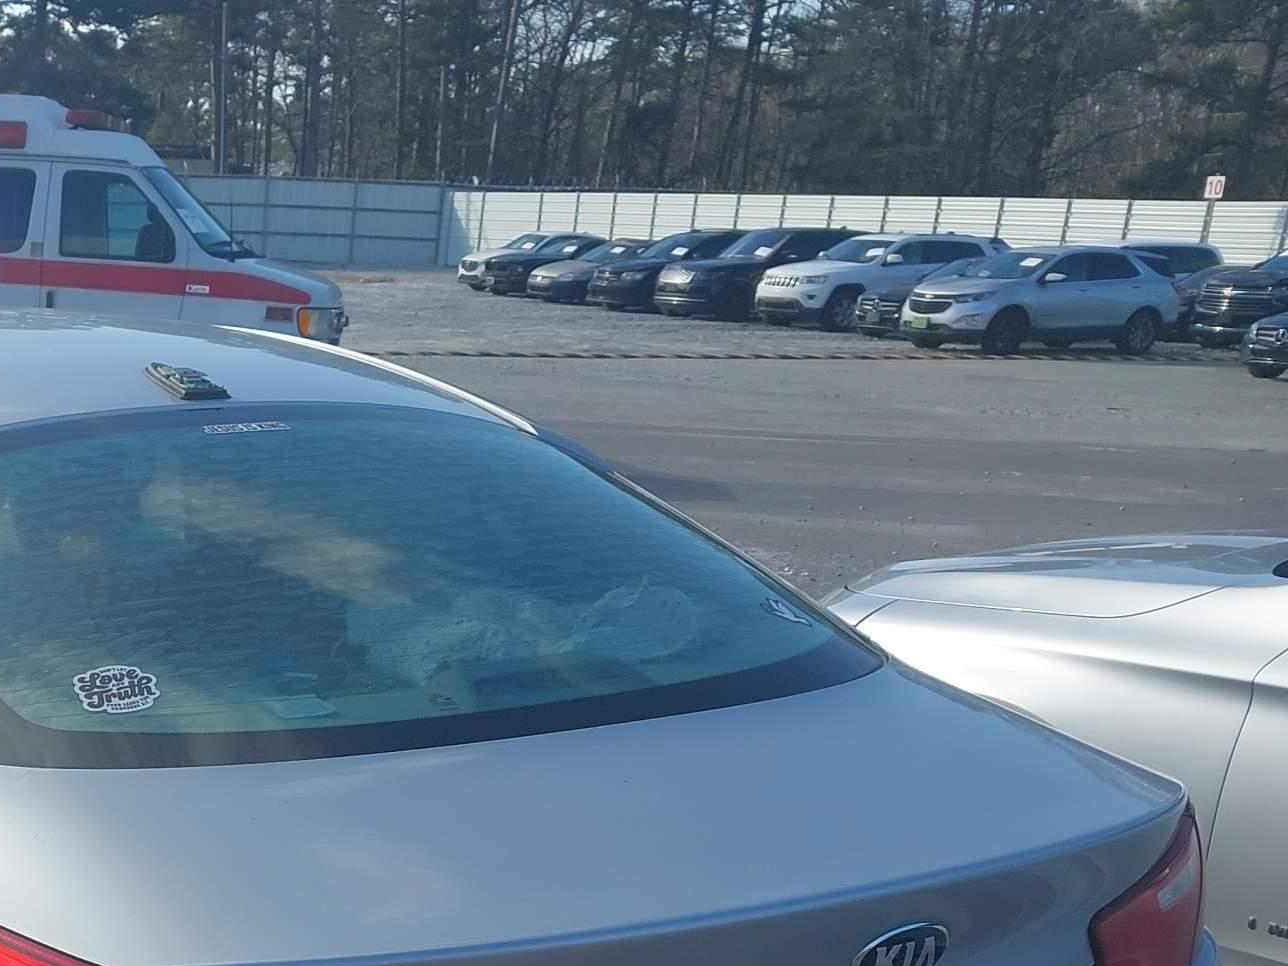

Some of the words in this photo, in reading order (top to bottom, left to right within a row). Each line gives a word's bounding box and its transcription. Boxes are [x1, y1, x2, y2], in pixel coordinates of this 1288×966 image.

[1208, 180, 1223, 196] 10
[77, 669, 139, 693] Love
[84, 676, 156, 709] Truth
